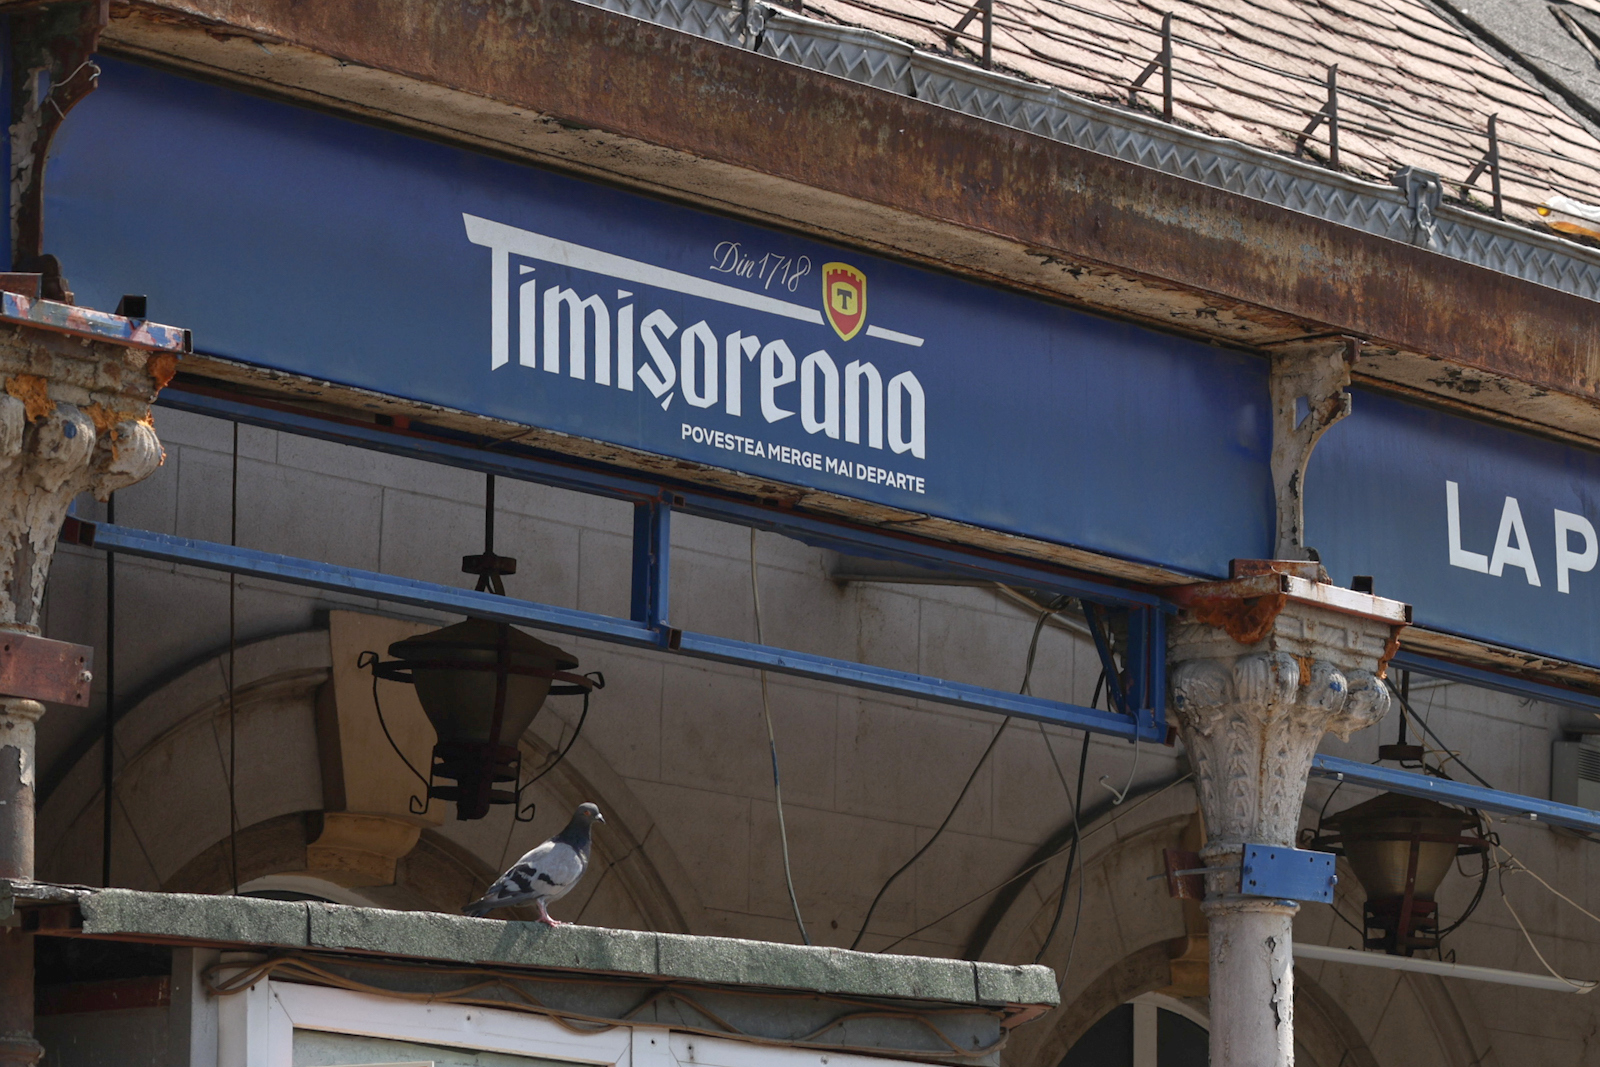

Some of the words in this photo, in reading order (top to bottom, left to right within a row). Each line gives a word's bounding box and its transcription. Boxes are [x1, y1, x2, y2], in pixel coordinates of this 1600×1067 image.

[710, 240, 755, 280] Din
[757, 250, 813, 293] 1718
[681, 423, 766, 459] POVESTEA
[767, 444, 822, 472] MERGE
[825, 458, 854, 477] MAI
[856, 465, 926, 494] DEPARTE
[1446, 480, 1541, 587] LA
